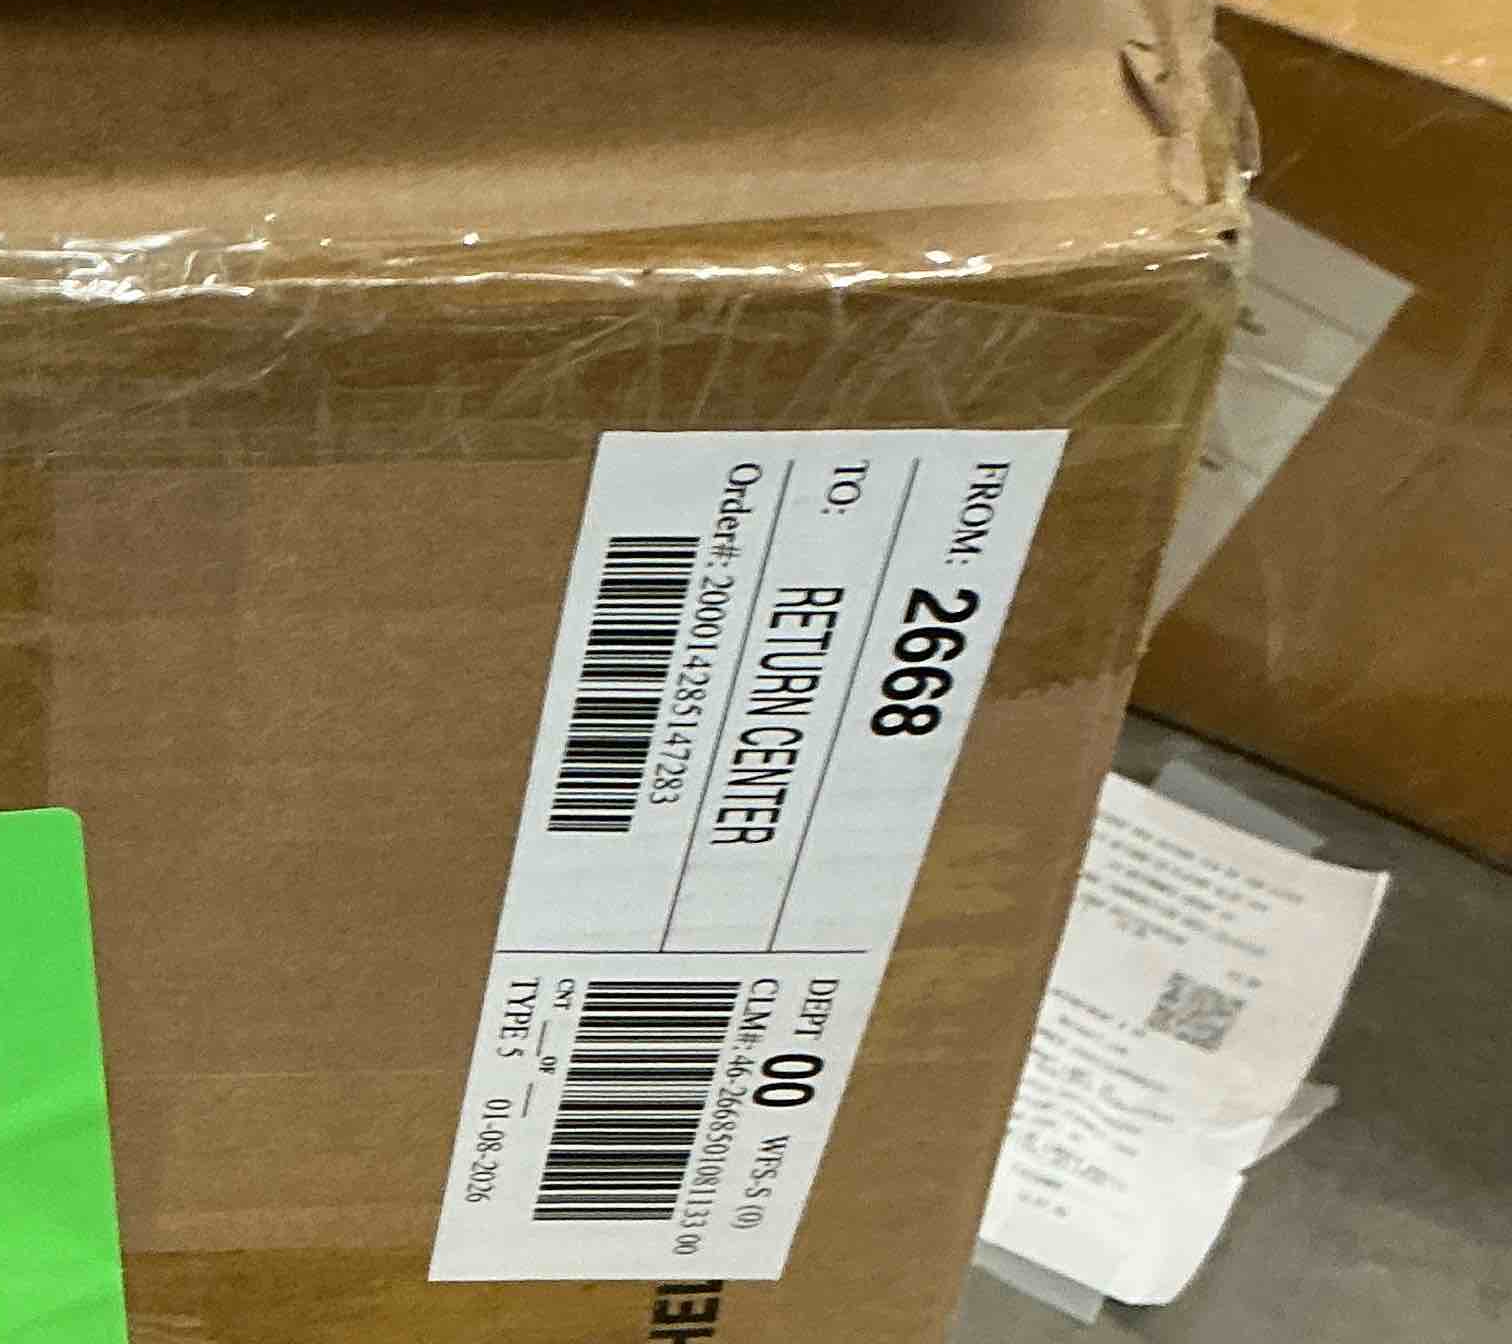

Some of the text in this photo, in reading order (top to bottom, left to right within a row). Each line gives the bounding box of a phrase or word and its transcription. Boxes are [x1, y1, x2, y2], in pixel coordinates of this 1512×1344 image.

[650, 462, 763, 806] Order#: 200014285147283
[711, 459, 871, 846] TO: RETURN CENTER
[870, 587, 981, 738] 2668
[498, 977, 541, 1042] TYPE
[539, 977, 576, 1076] CNT OF
[793, 977, 841, 1042] DEPT
[673, 978, 780, 1257] CLM#: 46-2668501081133 00
[752, 1052, 825, 1109] 00
[465, 1098, 513, 1204] 01-08-2026
